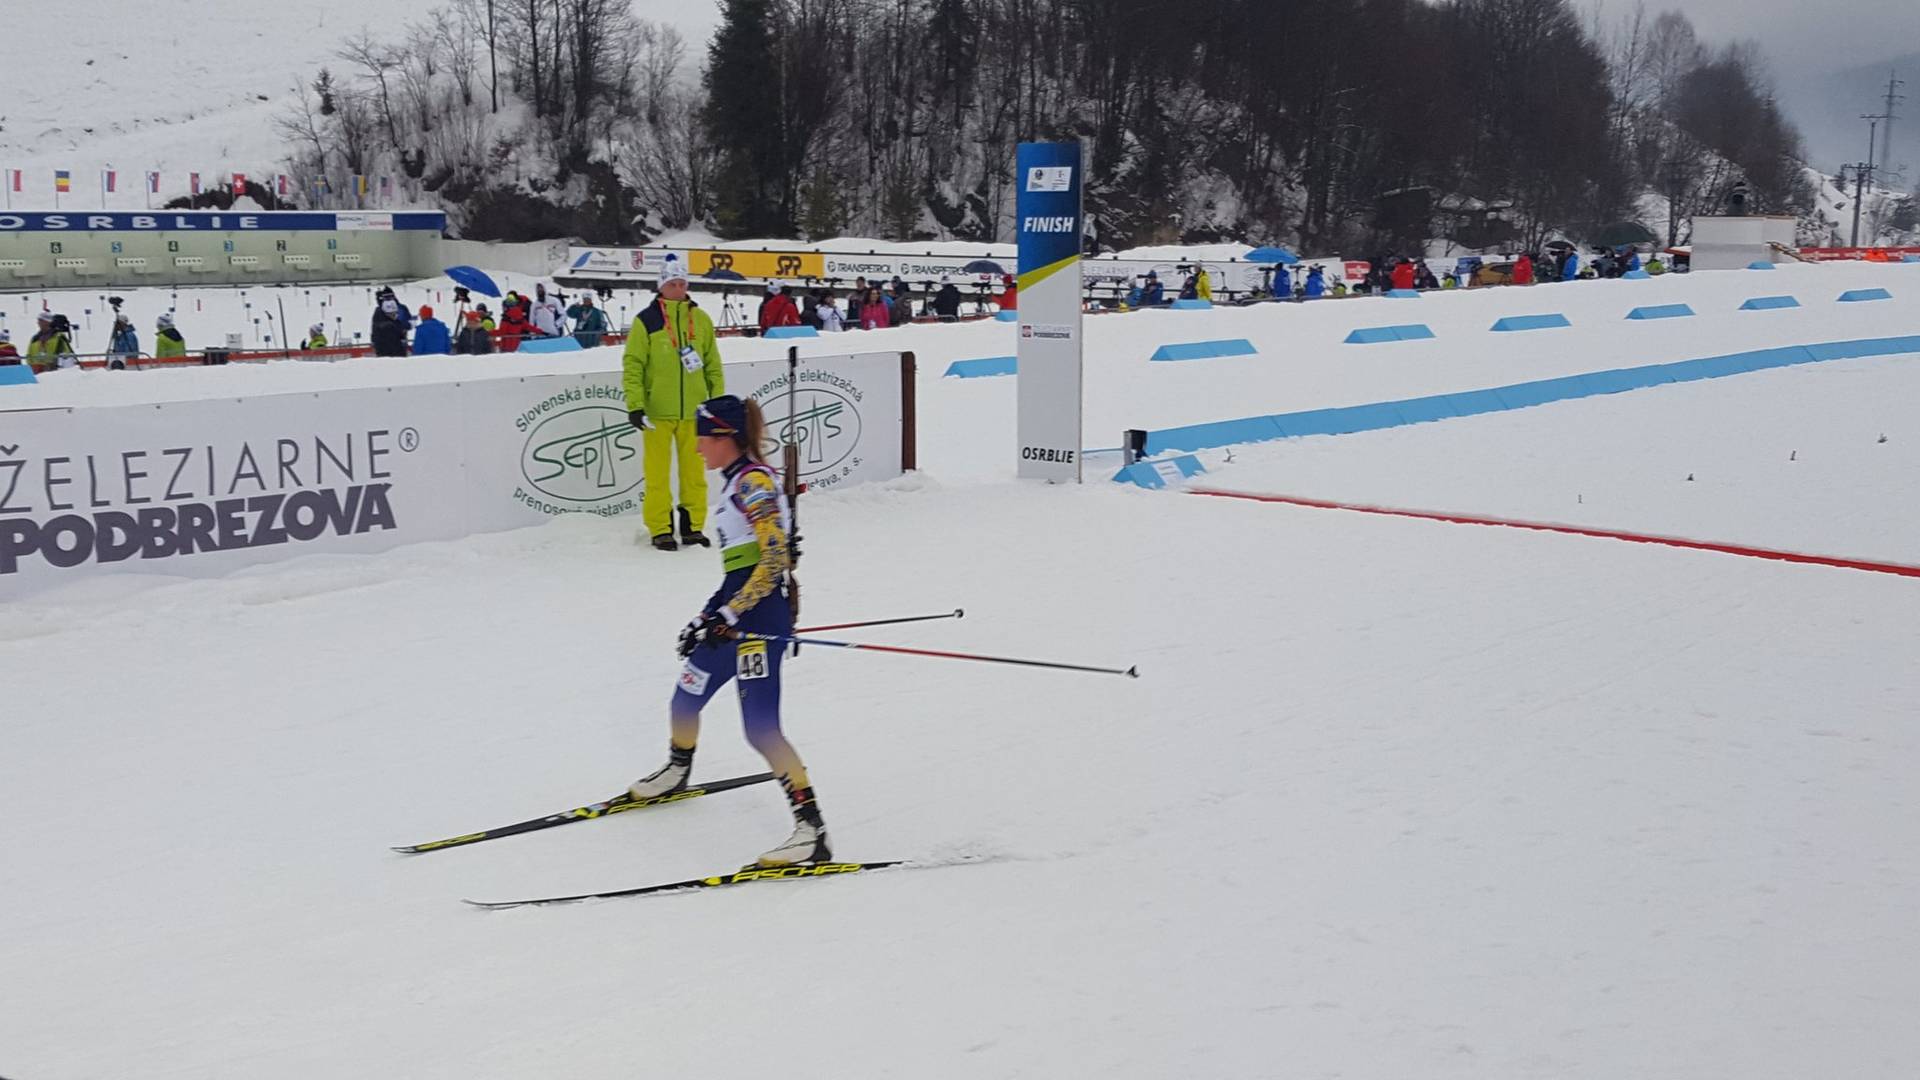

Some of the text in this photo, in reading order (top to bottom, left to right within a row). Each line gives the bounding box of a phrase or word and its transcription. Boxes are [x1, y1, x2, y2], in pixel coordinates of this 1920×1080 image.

[0, 215, 259, 229] OSRBLIE
[1023, 216, 1075, 233] FINISH
[837, 262, 892, 274] TRANSPETROL
[799, 369, 863, 403] elektrizačná
[515, 383, 626, 433] Slovenská elektr
[1022, 446, 1075, 464] OSRBLIE
[741, 652, 764, 678] 48
